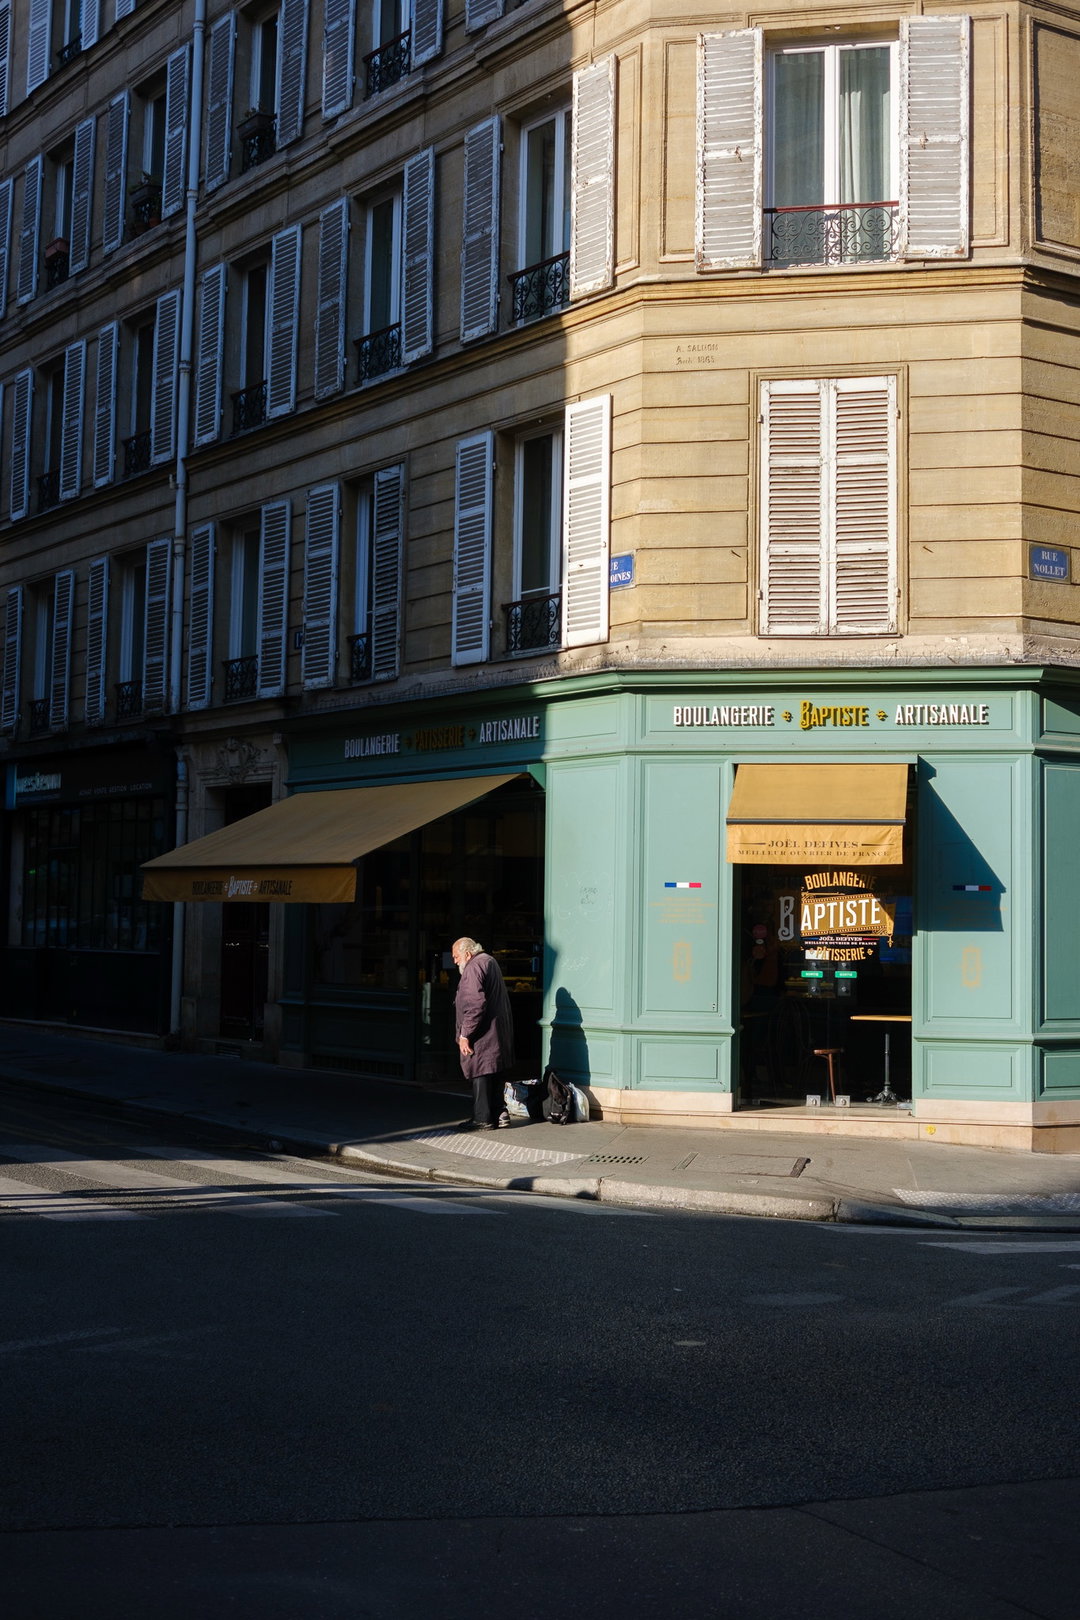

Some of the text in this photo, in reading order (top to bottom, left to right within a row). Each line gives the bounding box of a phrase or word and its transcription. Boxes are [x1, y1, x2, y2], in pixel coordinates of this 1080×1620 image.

[1041, 550, 1058, 562] RUE
[1033, 563, 1065, 577] NOLLET
[673, 700, 989, 729] BOULANGERIE BAPTISTE ARTISANALE
[344, 733, 400, 759] BOULANGERIE
[479, 716, 540, 744] ARTISANALE
[768, 838, 859, 849] JOËL DEFIVES
[258, 880, 293, 896] ARTISANALE
